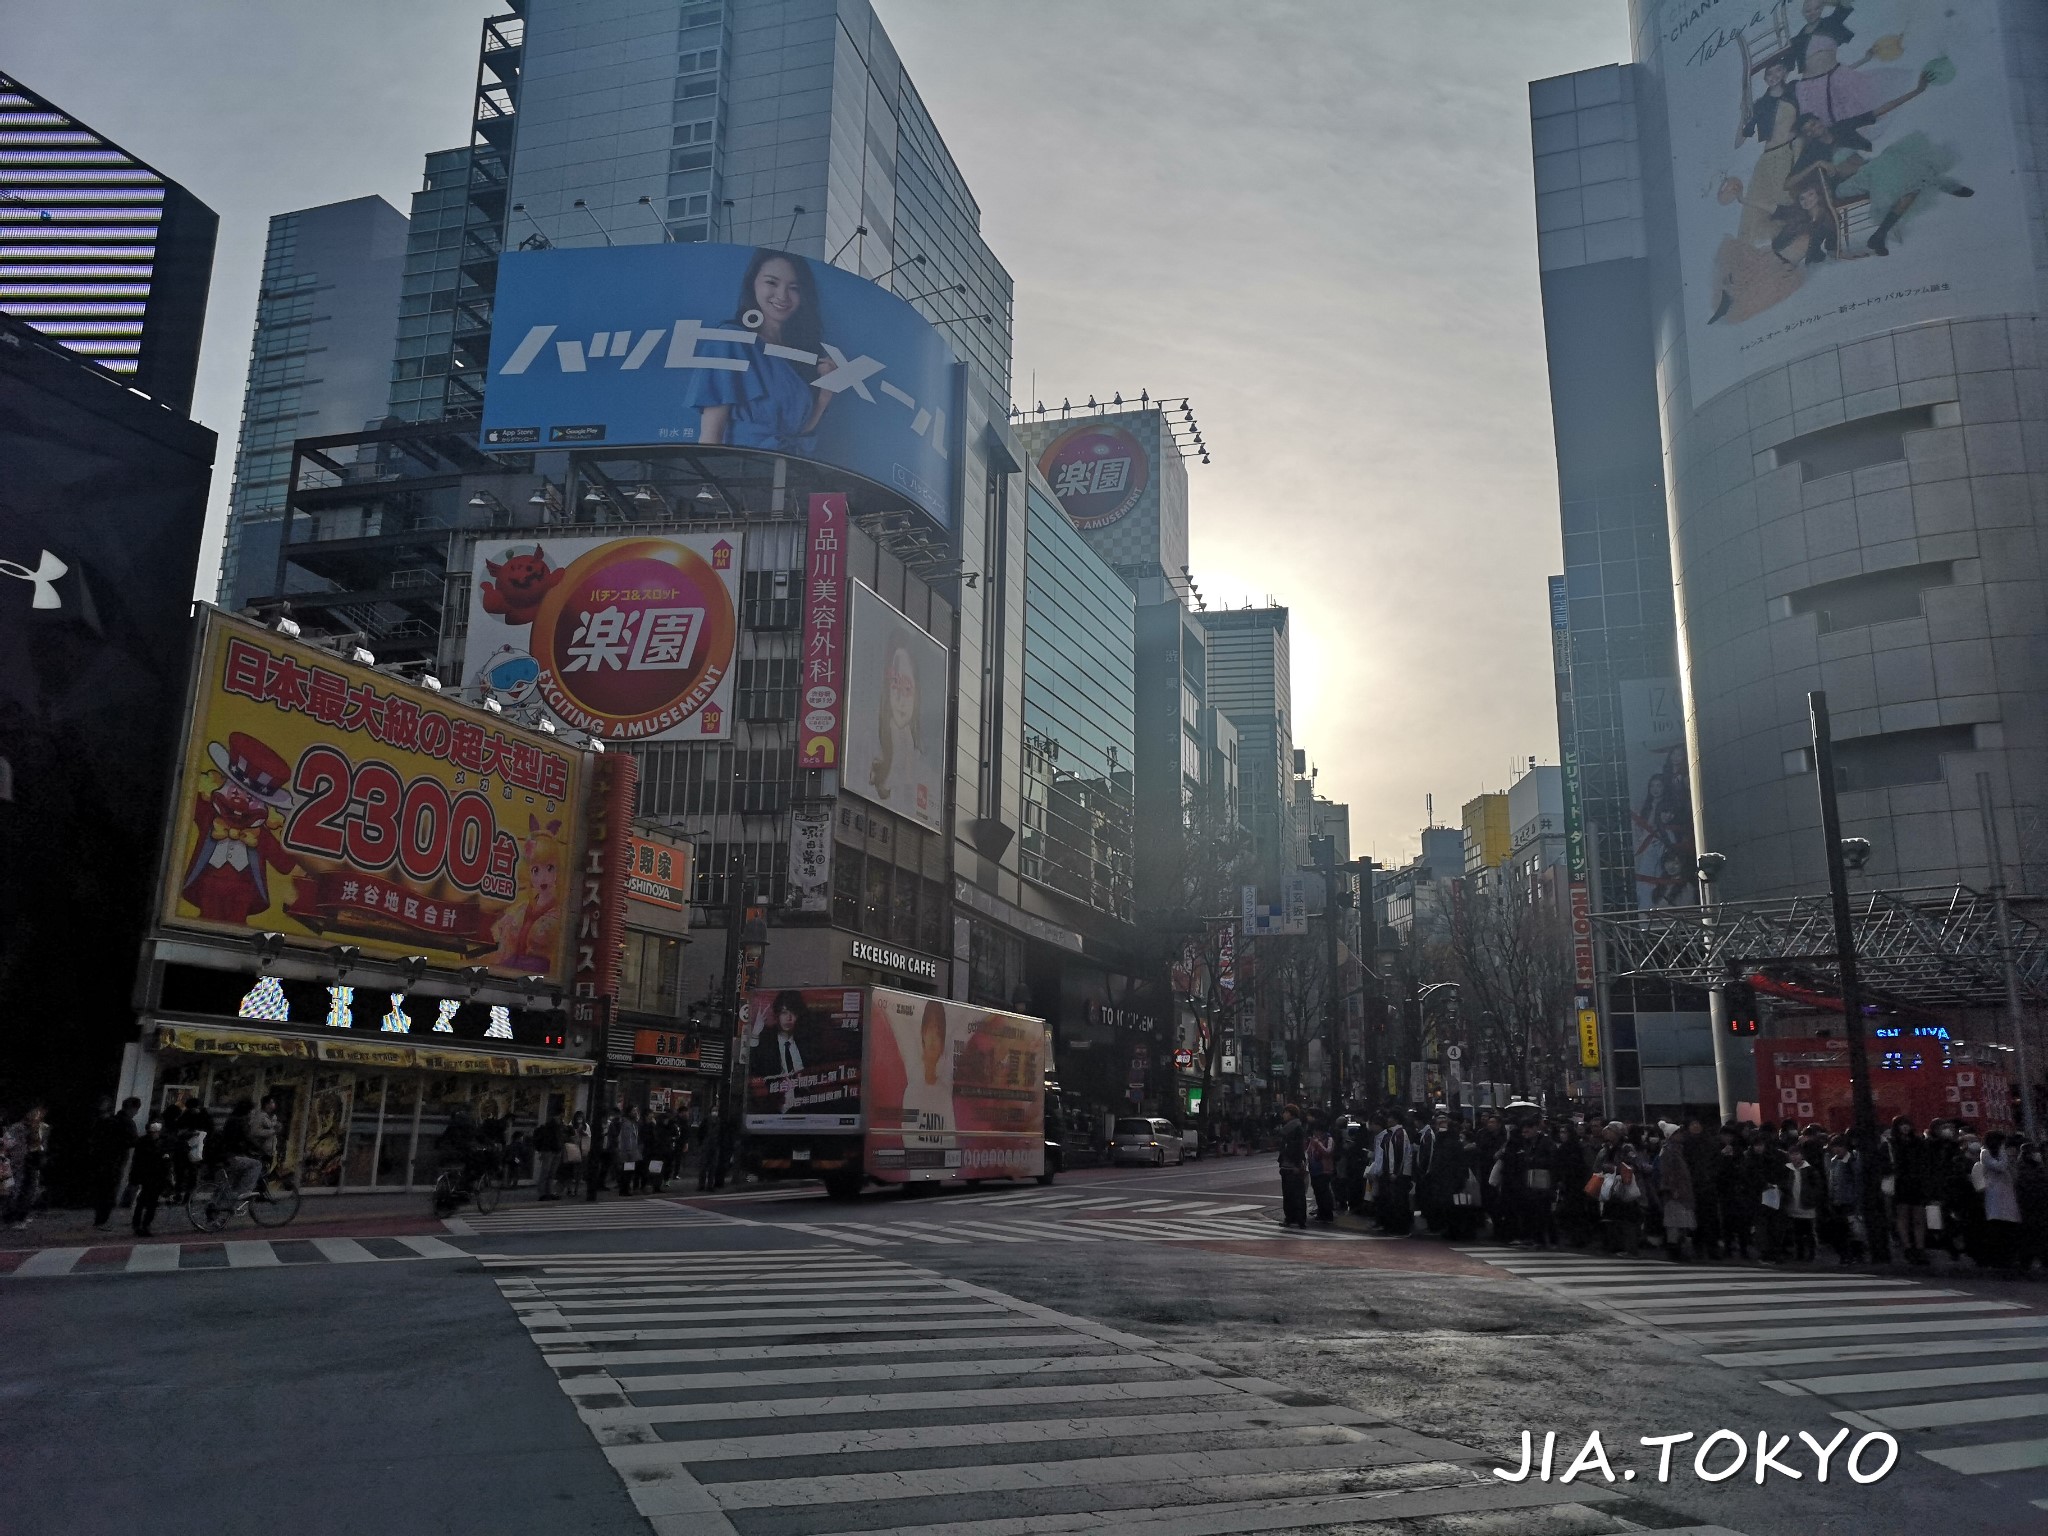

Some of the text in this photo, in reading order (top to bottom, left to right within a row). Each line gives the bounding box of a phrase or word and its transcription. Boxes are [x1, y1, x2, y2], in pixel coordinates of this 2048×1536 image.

[1670, 0, 1718, 42] CHAN
[500, 309, 948, 460] ハッピーメール
[1055, 457, 1131, 497] 楽園
[1084, 486, 1142, 529] AMUSEMENT
[714, 548, 729, 558] 40
[591, 587, 680, 602] パチンコ&スロット
[811, 527, 838, 683] 品川美容外科
[562, 605, 705, 672] 楽園
[223, 638, 569, 801] 日本最大級の超大型店
[537, 664, 722, 737] EXCITING AMUSEMENT
[704, 712, 719, 723] 30
[1165, 650, 1179, 792] 渋東シネタ
[284, 744, 518, 891] 2300 台
[1566, 751, 1585, 870] ビリヤード・ダーツ
[482, 875, 515, 900] OVER
[624, 878, 670, 900] OSHINOYA
[1574, 873, 1586, 881] 3F
[342, 880, 457, 928] 渋谷地区合計
[852, 941, 906, 970] EXCELSIOR
[1571, 890, 1594, 980] HOOTERS
[250, 1043, 280, 1052] STAGE
[372, 1053, 399, 1061] STAGE
[656, 1056, 686, 1067] YOSHINOYA
